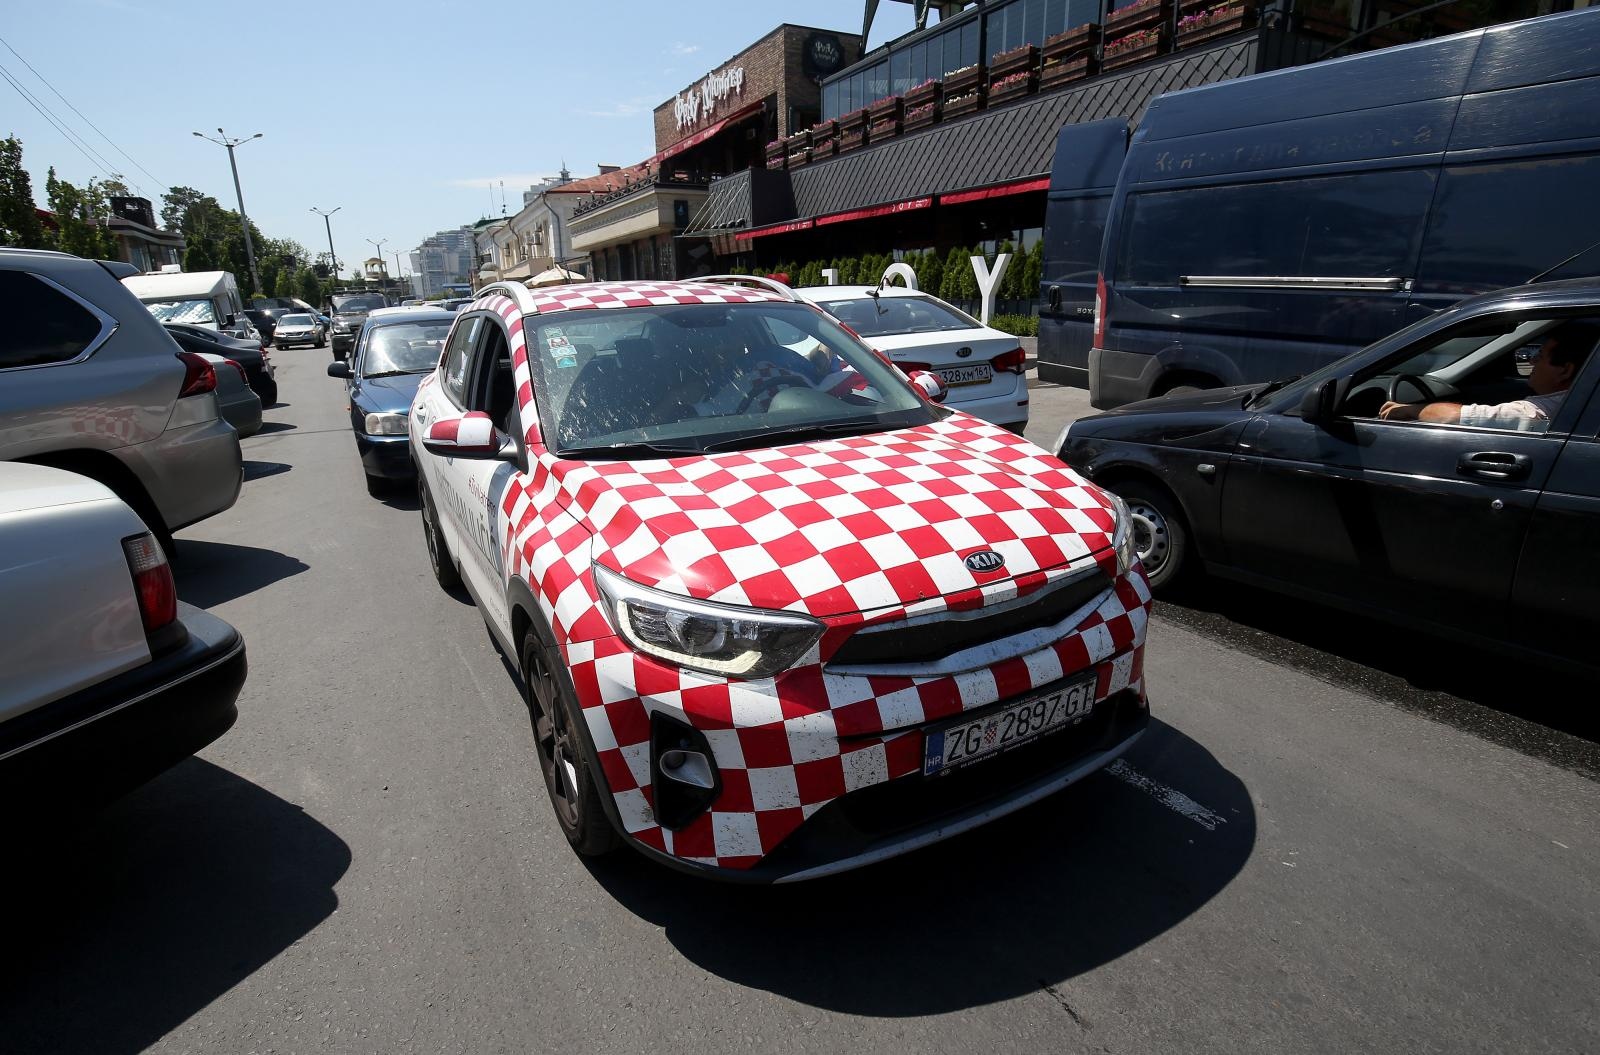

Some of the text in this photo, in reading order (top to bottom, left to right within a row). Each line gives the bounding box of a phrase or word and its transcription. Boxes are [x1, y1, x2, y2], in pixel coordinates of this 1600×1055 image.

[969, 552, 1002, 569] KIA
[927, 755, 942, 767] HR
[947, 723, 982, 763] ZG
